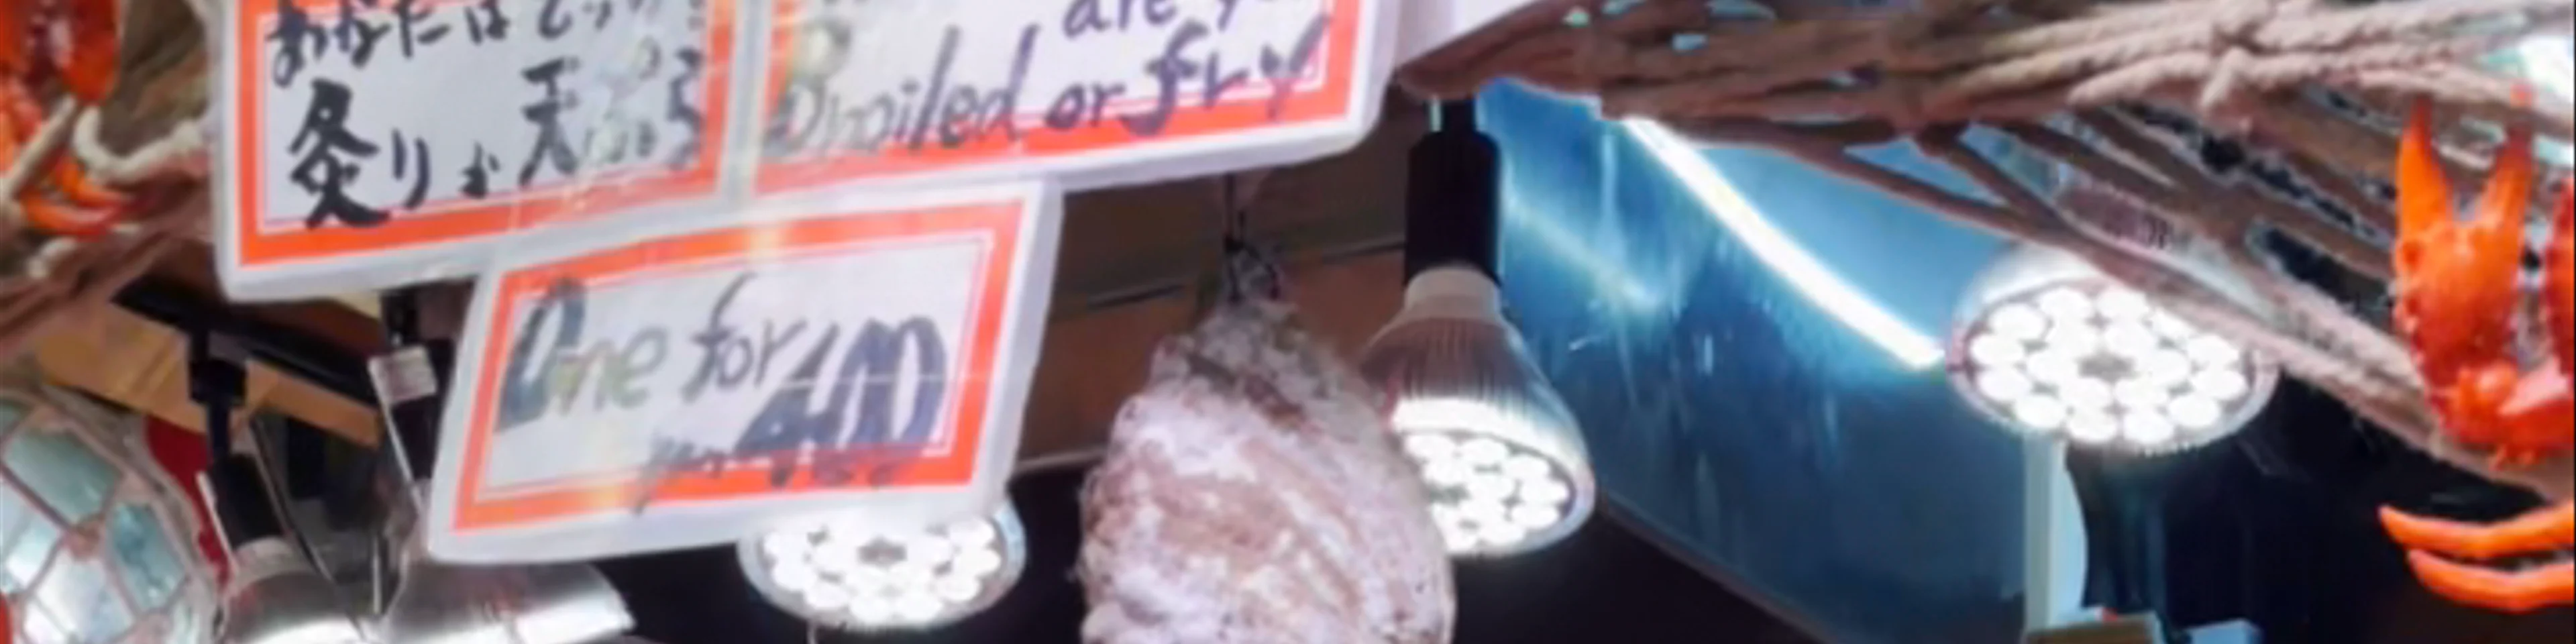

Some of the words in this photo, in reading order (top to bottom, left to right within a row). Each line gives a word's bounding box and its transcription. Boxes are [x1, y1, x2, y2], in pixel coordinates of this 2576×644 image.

[1044, 83, 1126, 130] or
[494, 277, 667, 433] One
[680, 271, 809, 402] for
